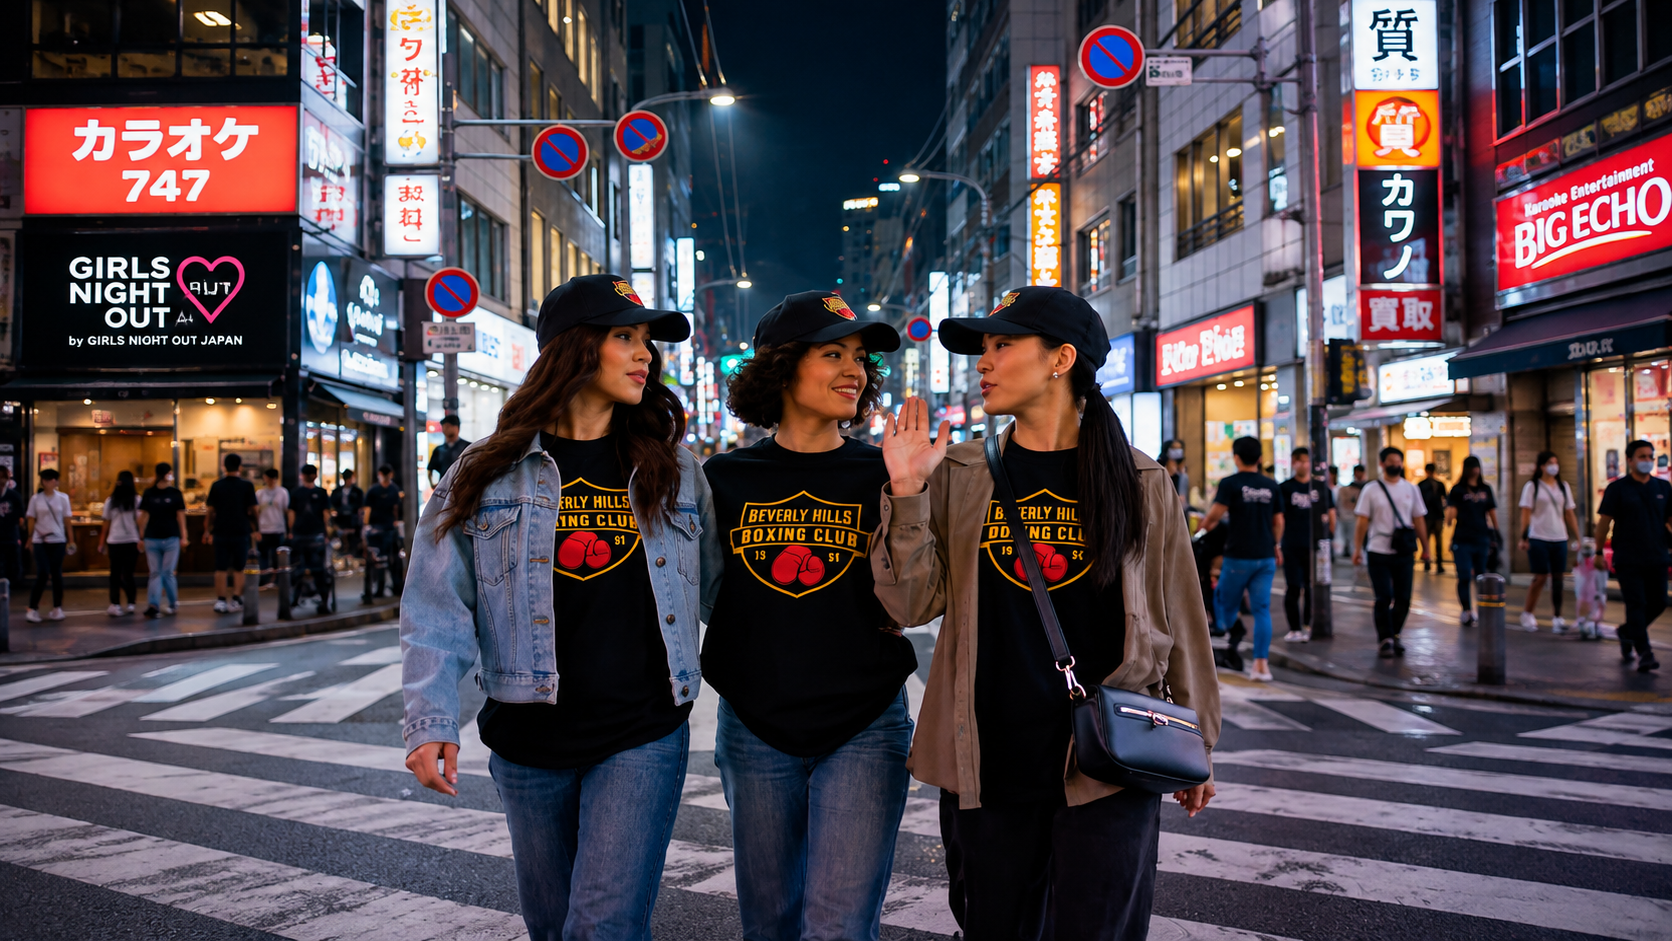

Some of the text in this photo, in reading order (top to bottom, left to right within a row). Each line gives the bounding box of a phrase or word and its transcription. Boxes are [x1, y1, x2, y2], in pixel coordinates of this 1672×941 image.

[1369, 8, 1418, 62] 質
[72, 117, 259, 161] カラオケ
[122, 169, 211, 202] 747
[1381, 172, 1415, 280] カワノ
[1514, 176, 1672, 269] BIG ECHO
[69, 256, 170, 279] GIRLS
[69, 282, 170, 304] NIGHT
[104, 307, 170, 328] OUT
[68, 335, 243, 347] by GIRLS NIGHT OUT JAPAN
[594, 495, 630, 509] HILLS
[748, 508, 852, 525] BEVERLY HILLS
[741, 527, 858, 547] BOXING CLUB
